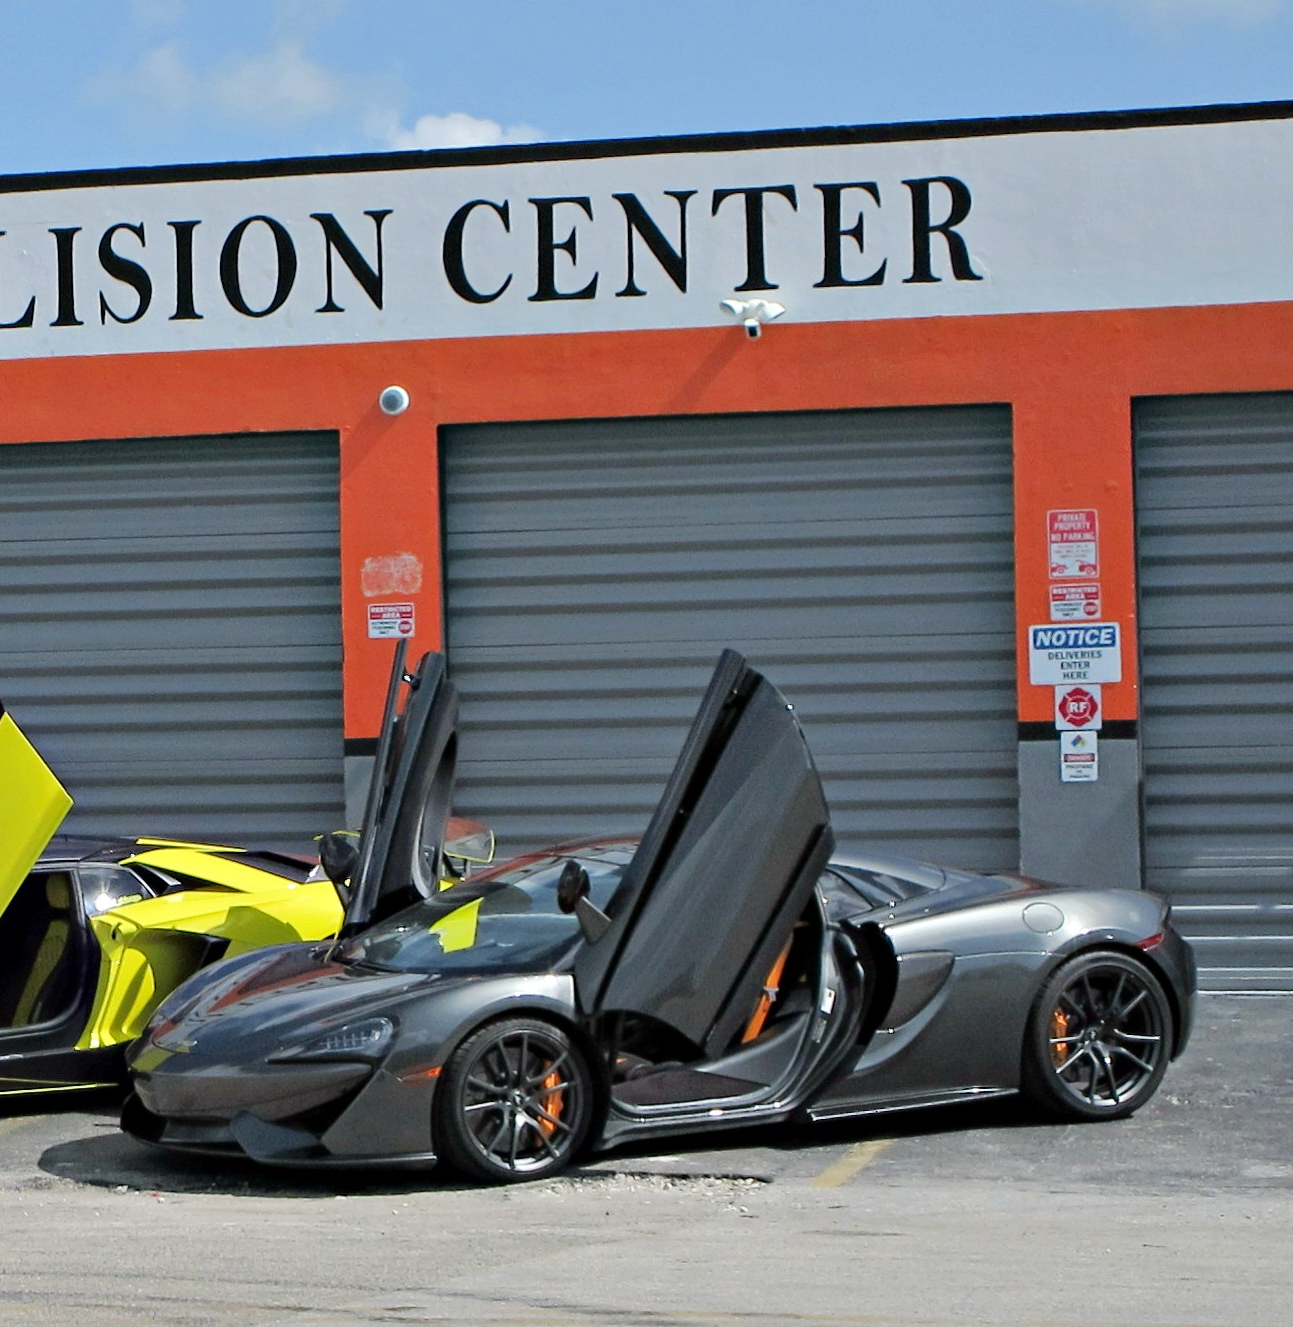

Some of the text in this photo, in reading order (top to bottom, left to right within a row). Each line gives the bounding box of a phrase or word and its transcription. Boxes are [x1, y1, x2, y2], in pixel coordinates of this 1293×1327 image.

[442, 176, 985, 306] CENTER
[1054, 521, 1090, 531] PROPERTY
[1063, 531, 1095, 541] PARKING
[1035, 628, 1114, 648] NOTICE
[1048, 650, 1102, 661] DELIVERIES
[1060, 661, 1090, 670] ENTER
[1062, 671, 1088, 680] HERE
[1069, 702, 1087, 713] RF
